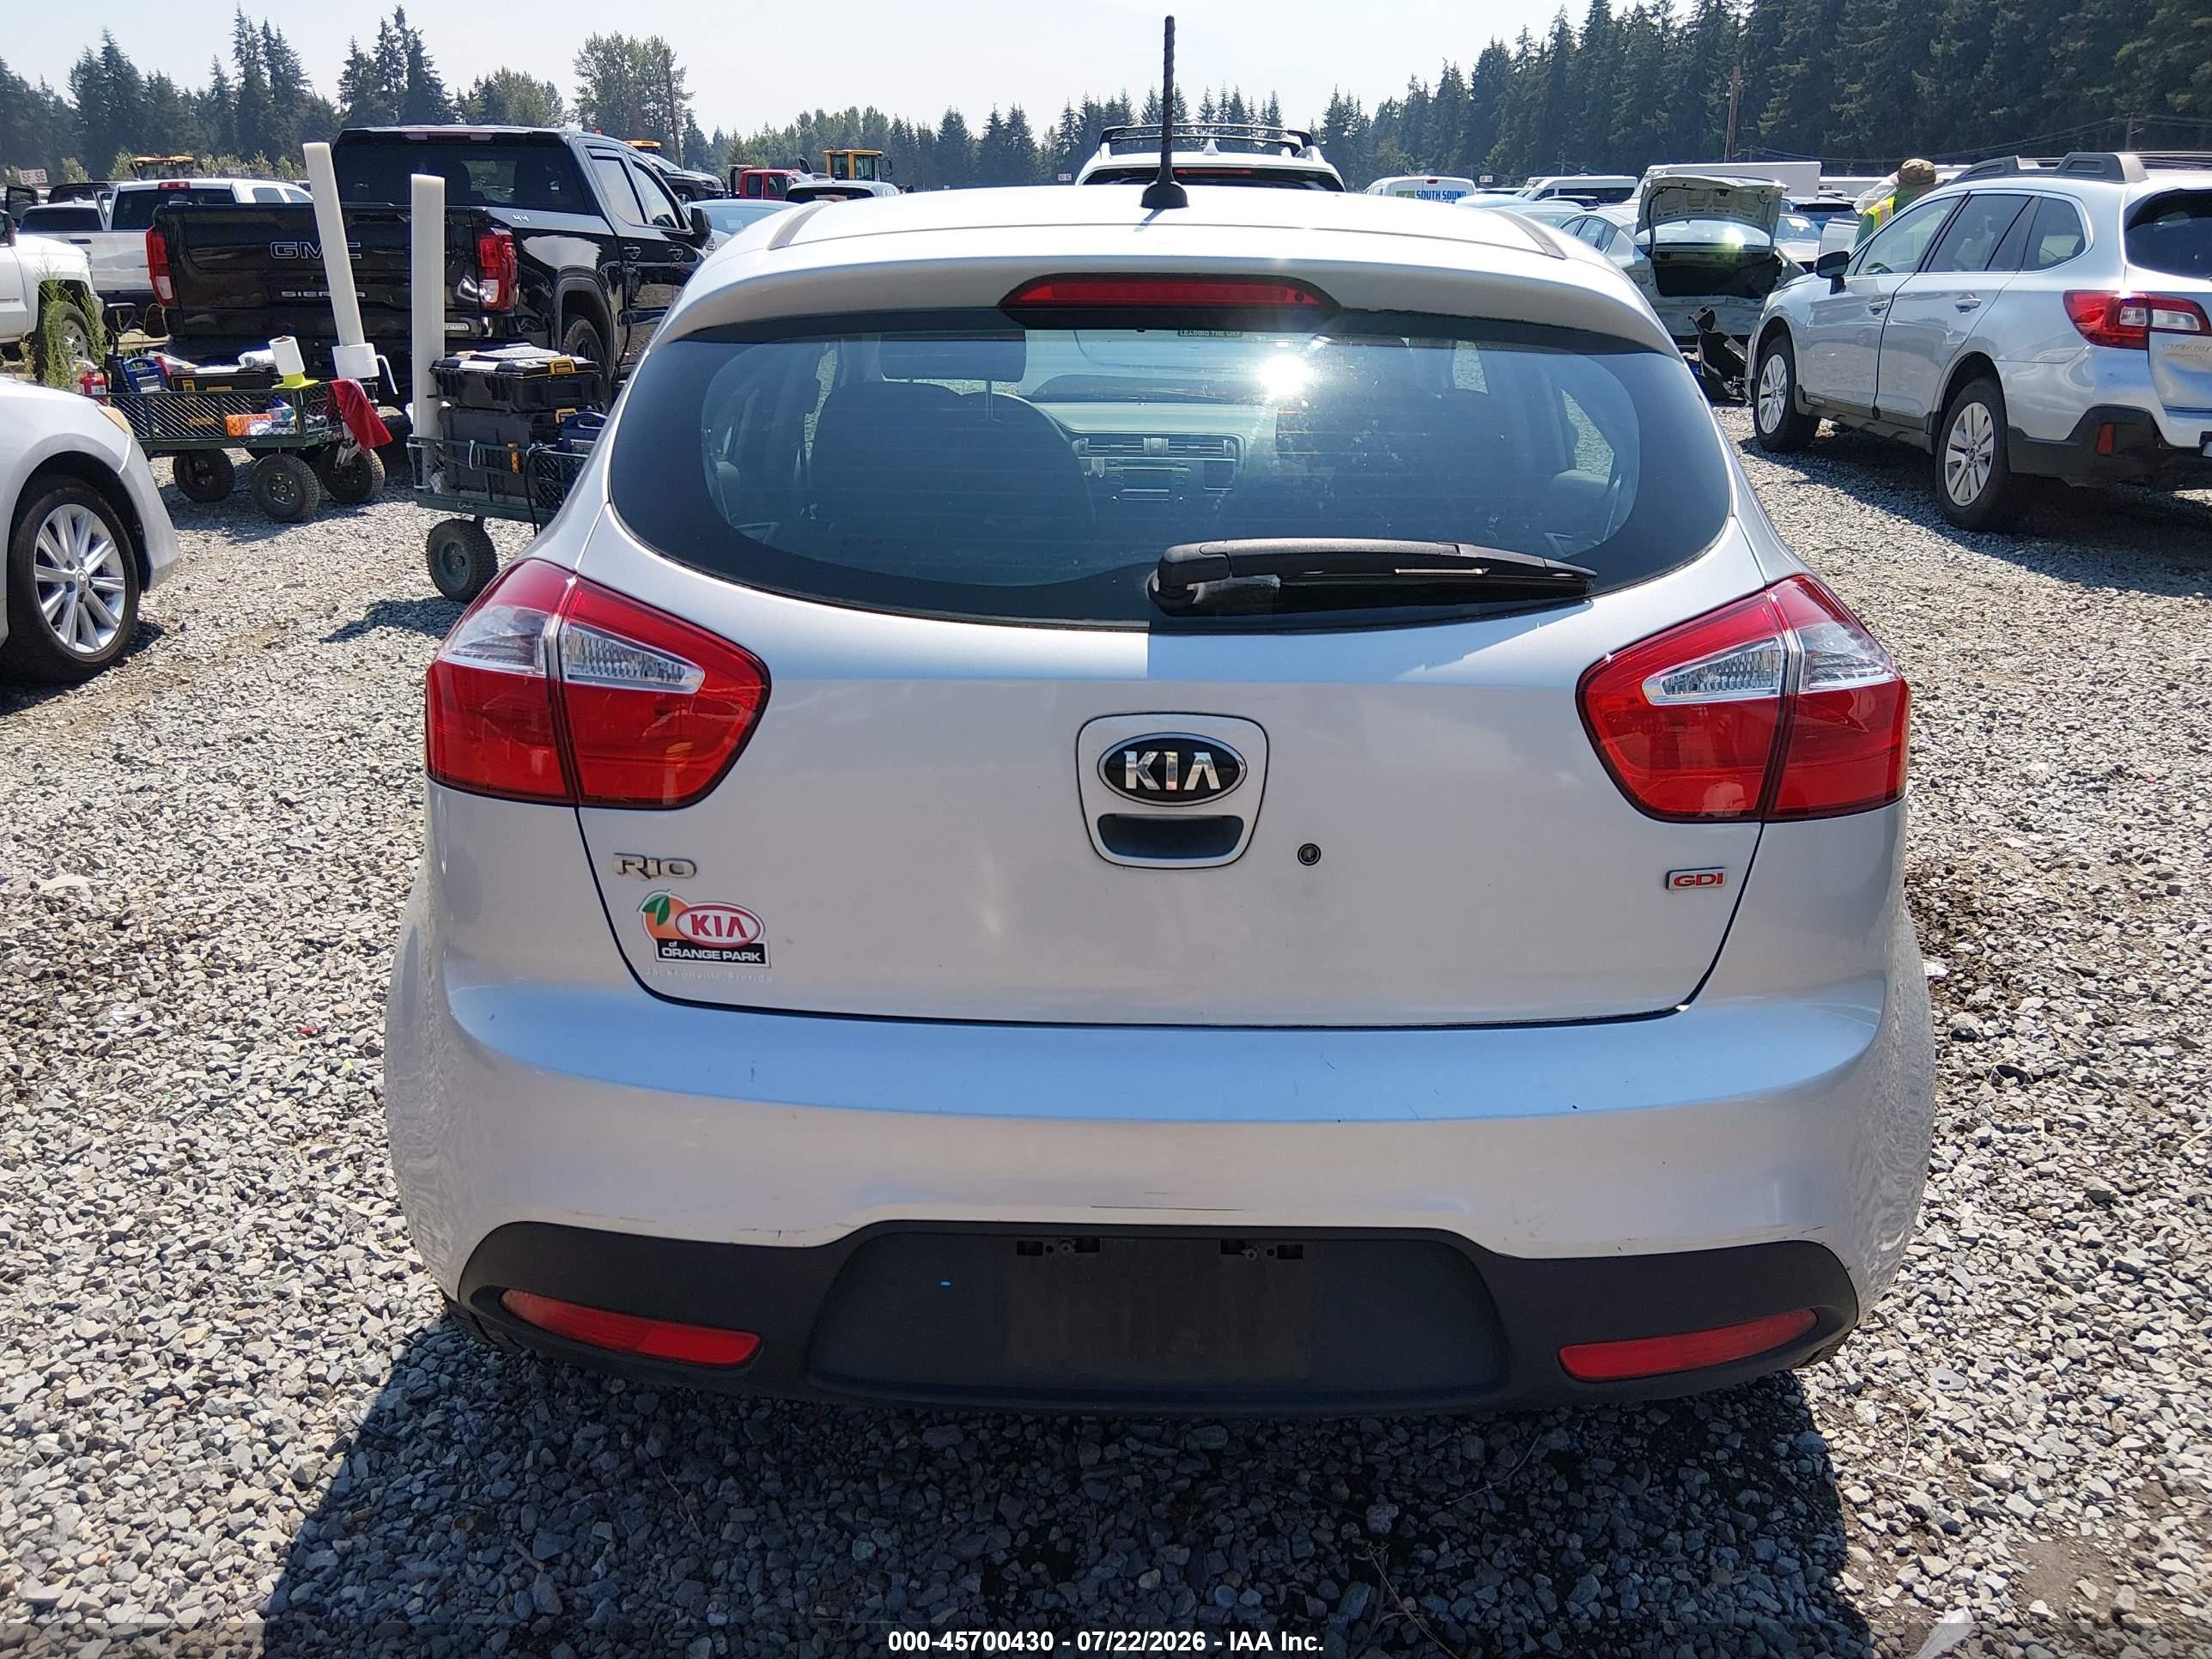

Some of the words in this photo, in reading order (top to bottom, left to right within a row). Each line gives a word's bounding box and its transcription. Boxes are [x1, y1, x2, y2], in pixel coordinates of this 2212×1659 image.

[1416, 190, 1441, 200] SOUTH
[1124, 750, 1221, 790] KIA
[613, 853, 697, 879] RIO
[1674, 872, 1723, 887] GDI
[690, 914, 749, 939] KIA
[661, 947, 721, 960] ORANGE
[722, 951, 762, 962] PARK
